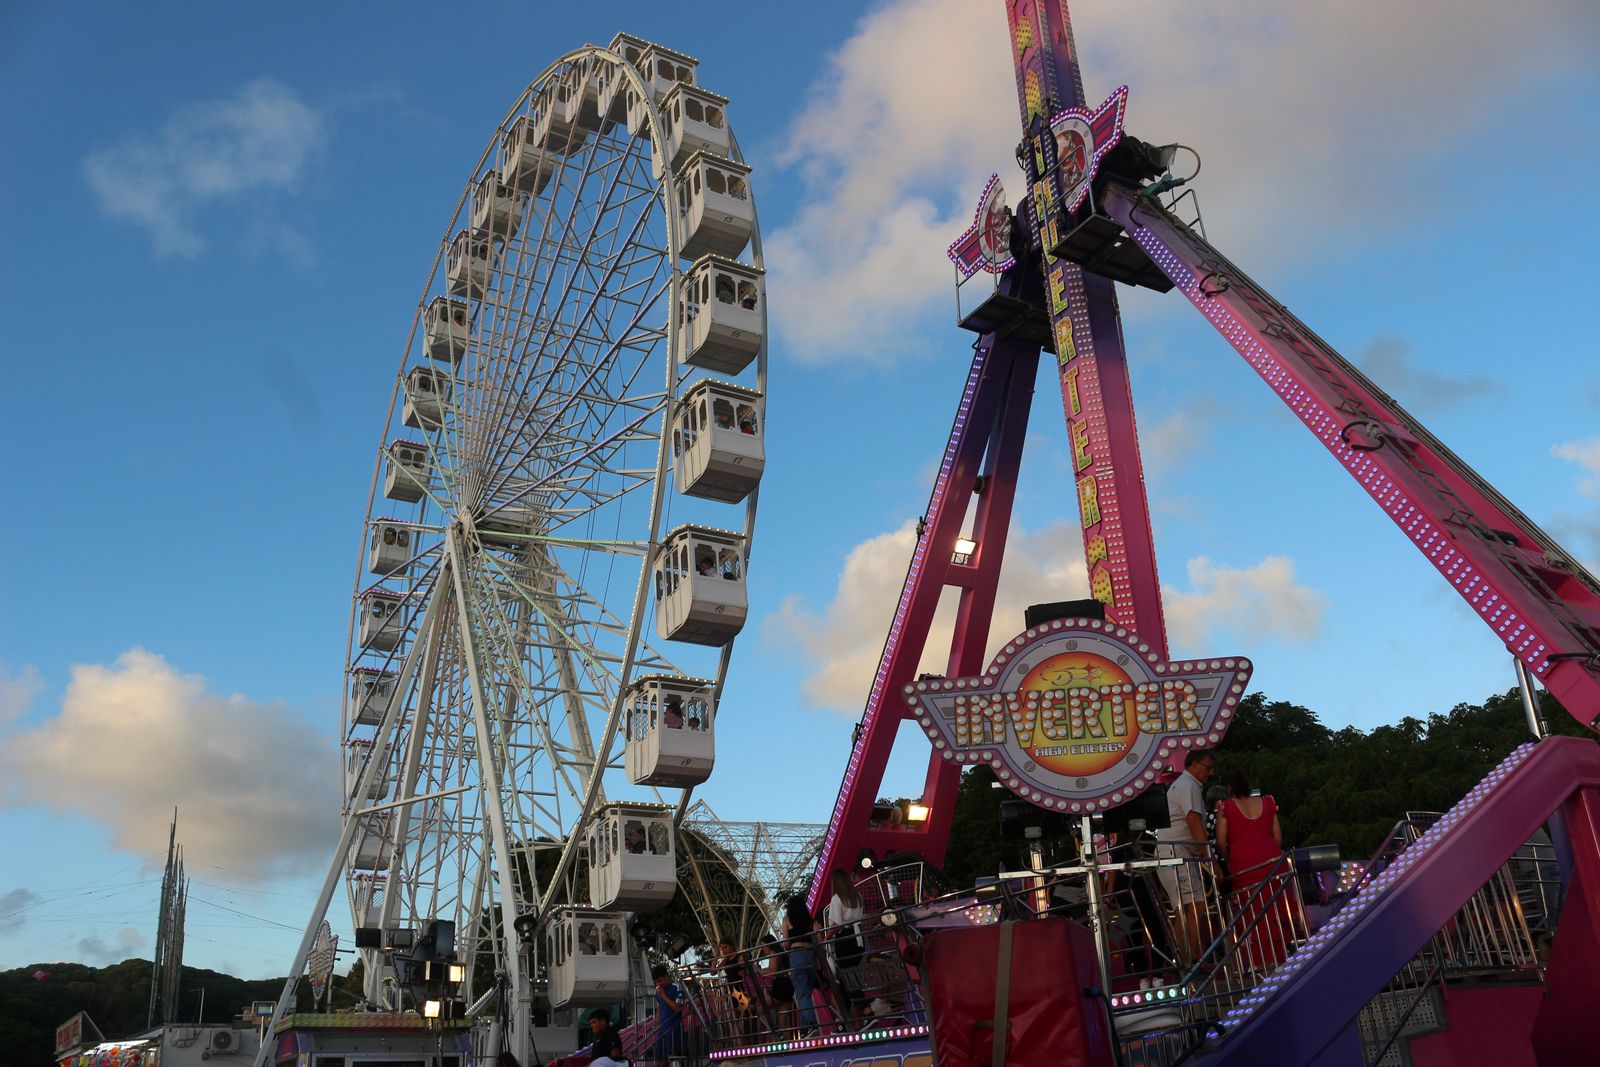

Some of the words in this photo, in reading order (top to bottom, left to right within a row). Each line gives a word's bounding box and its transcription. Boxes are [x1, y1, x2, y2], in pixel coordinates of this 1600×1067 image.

[955, 681, 1201, 748] INVERTER
[1035, 746, 1068, 757] HIGH
[1072, 743, 1127, 755] ENERGY
